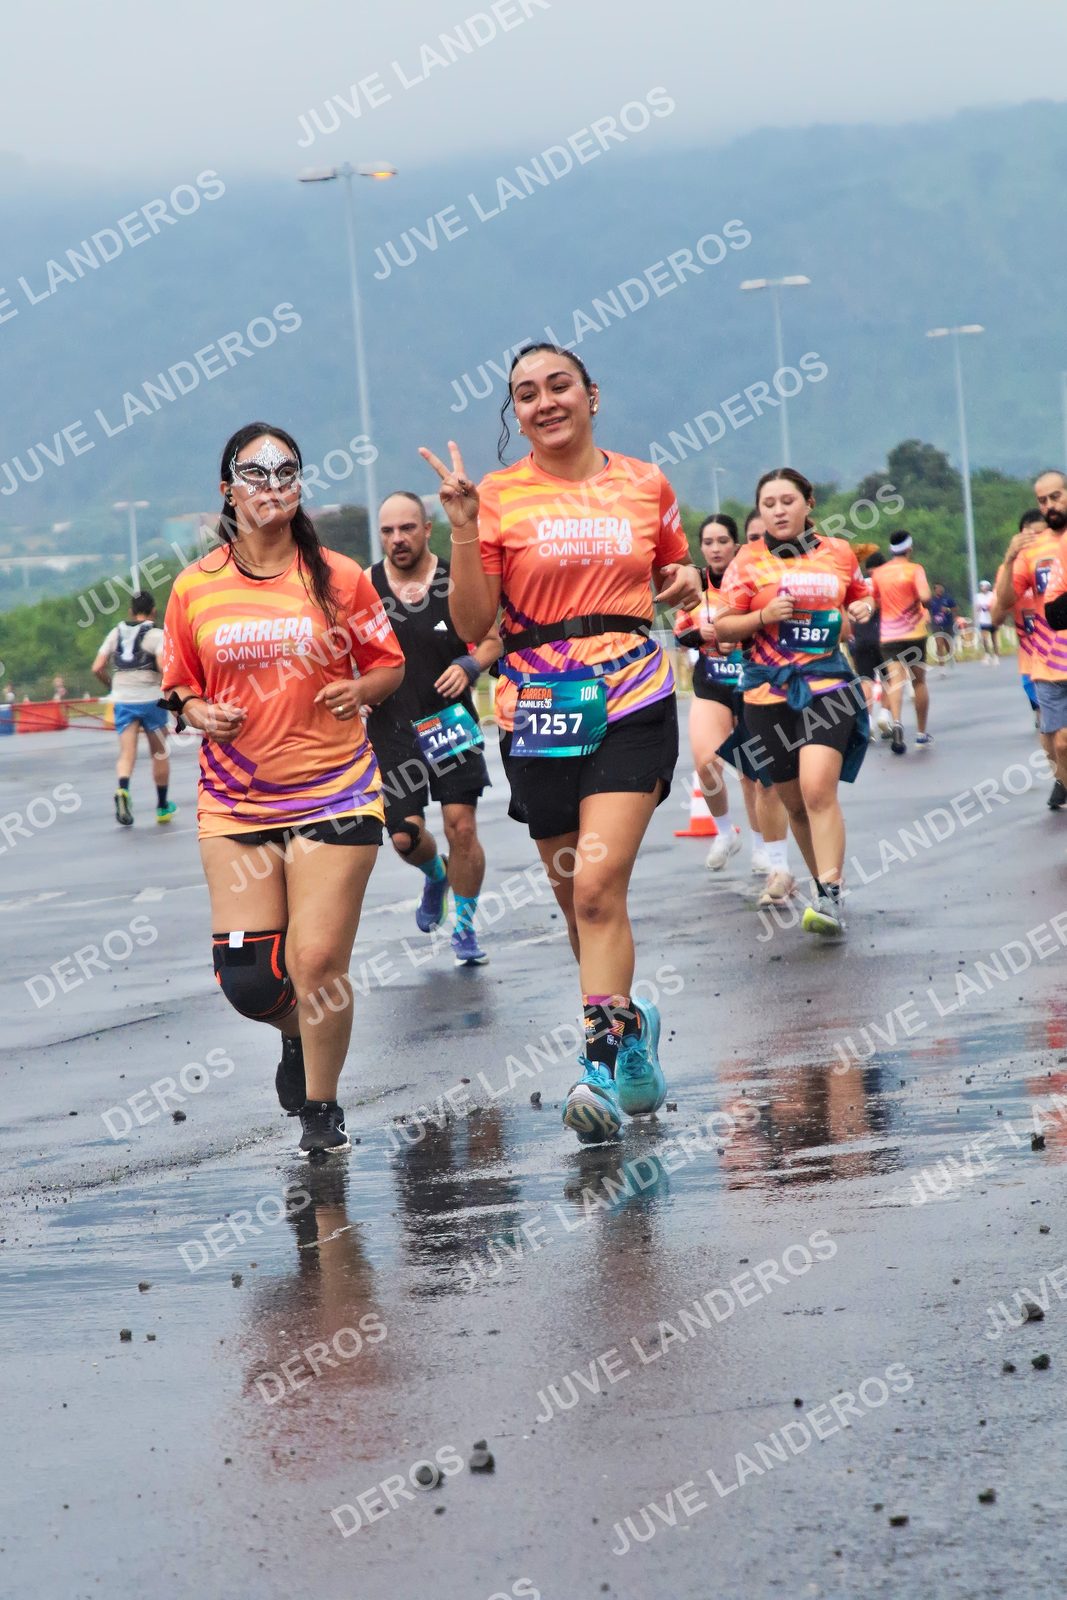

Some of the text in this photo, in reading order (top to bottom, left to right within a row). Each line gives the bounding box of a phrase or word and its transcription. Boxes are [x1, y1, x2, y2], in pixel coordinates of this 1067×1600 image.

[538, 517, 633, 541] CARRERA
[539, 541, 614, 557] OMNILIFE
[215, 616, 313, 646] CARRERA
[792, 627, 830, 641] 1387
[216, 642, 291, 663] OMNILIFE
[580, 684, 599, 702] 10K
[527, 712, 583, 735] 1257
[428, 723, 466, 748] 1441
